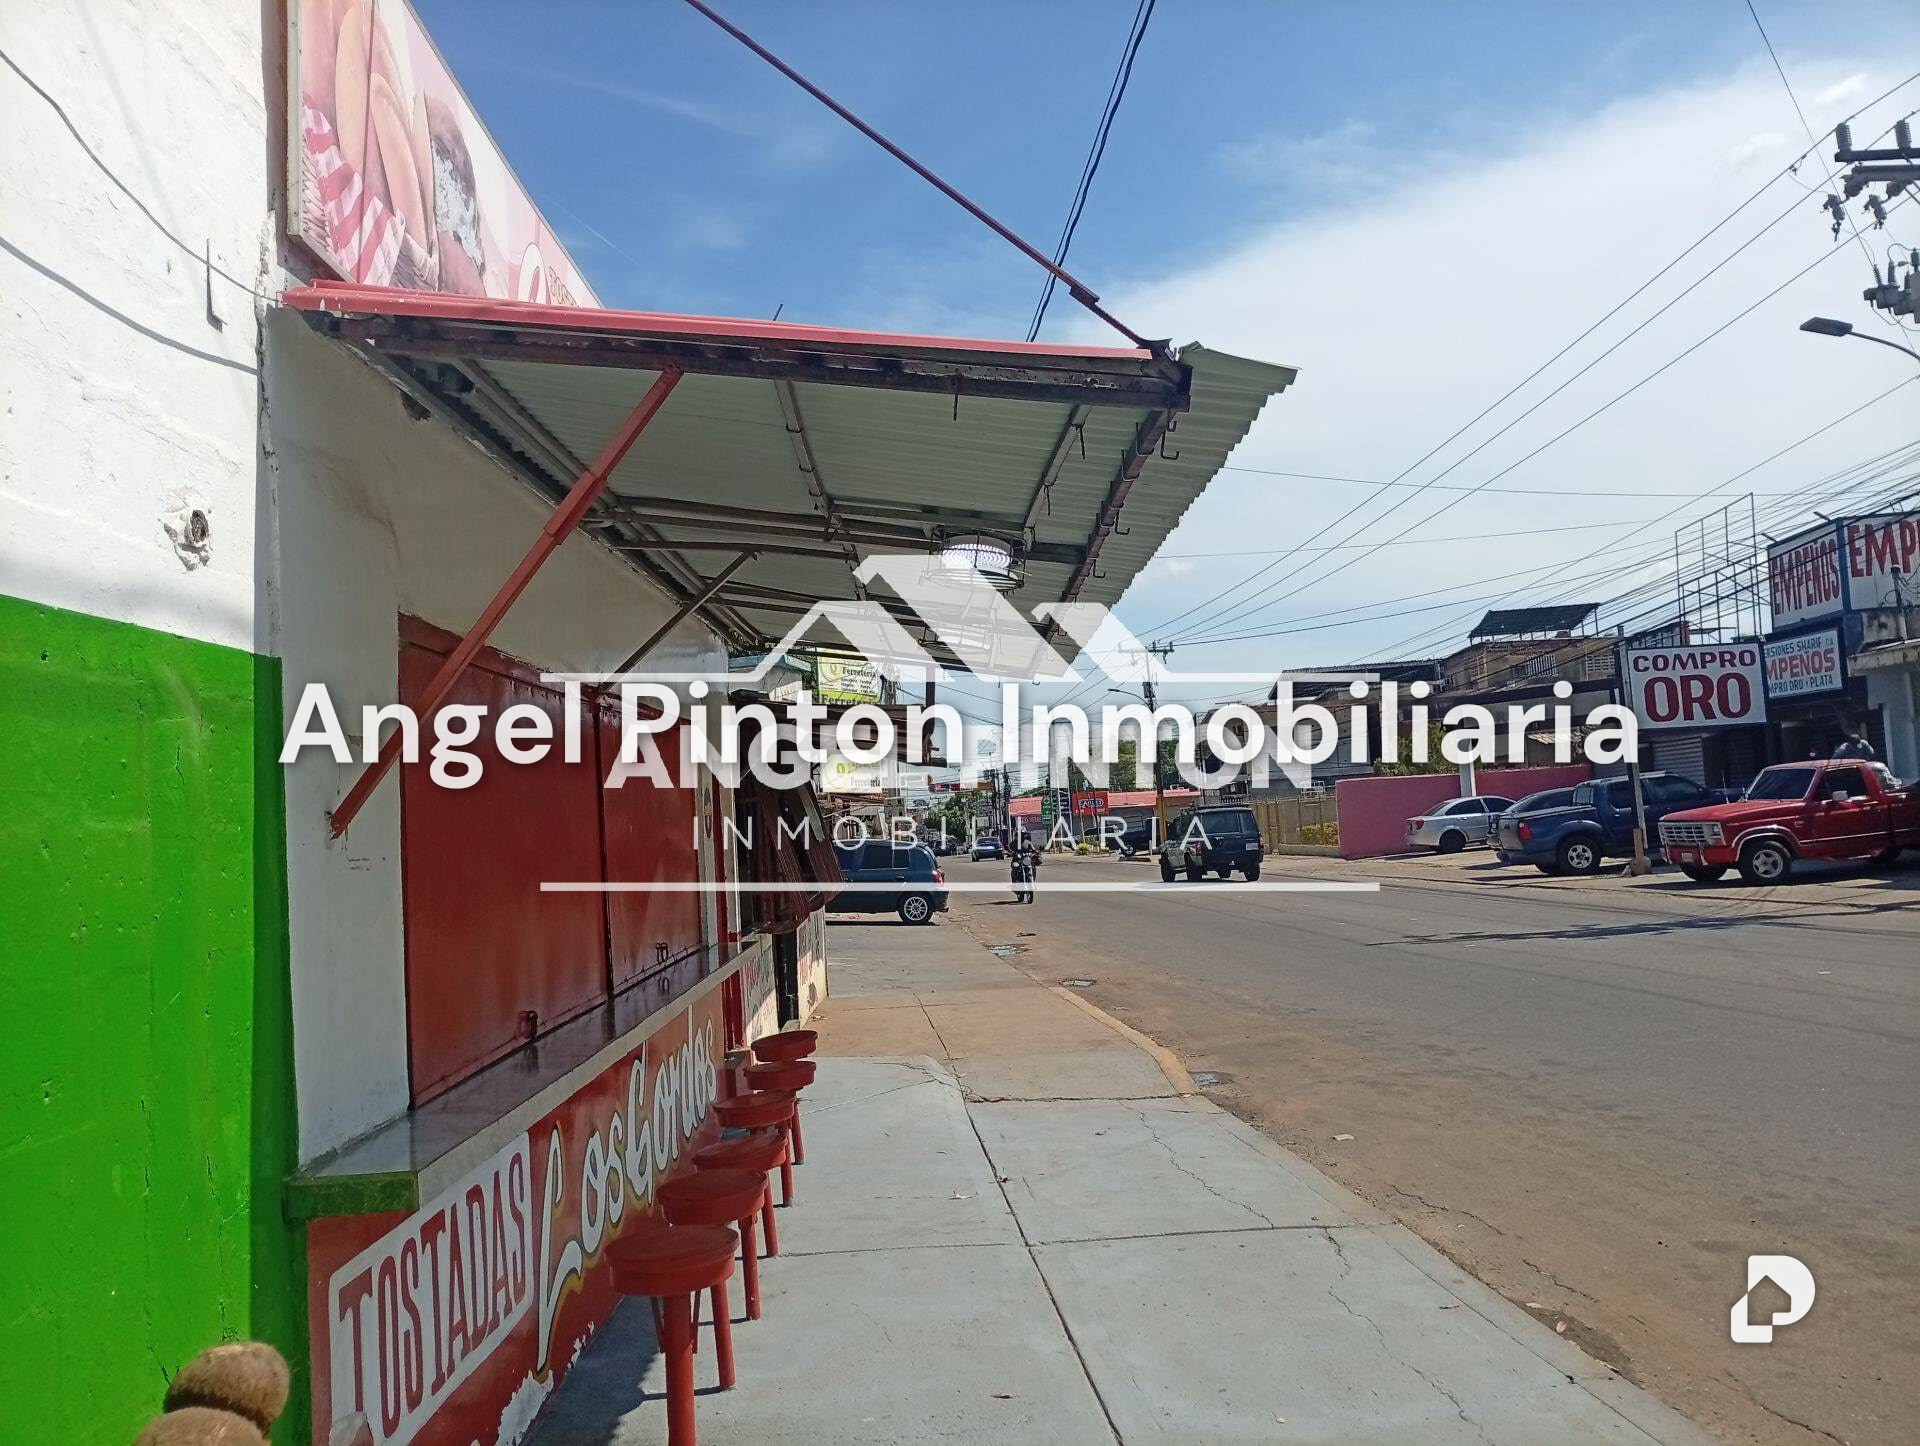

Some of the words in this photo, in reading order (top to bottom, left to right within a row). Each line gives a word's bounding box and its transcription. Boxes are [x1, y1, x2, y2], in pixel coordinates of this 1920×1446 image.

[1847, 518, 1920, 578] EMP
[1632, 649, 1757, 673] COMPRO
[1810, 674, 1834, 688] PLATA
[1643, 672, 1751, 723] ORO
[536, 1111, 625, 1371] Los
[338, 1152, 527, 1439] TOSTADAS
